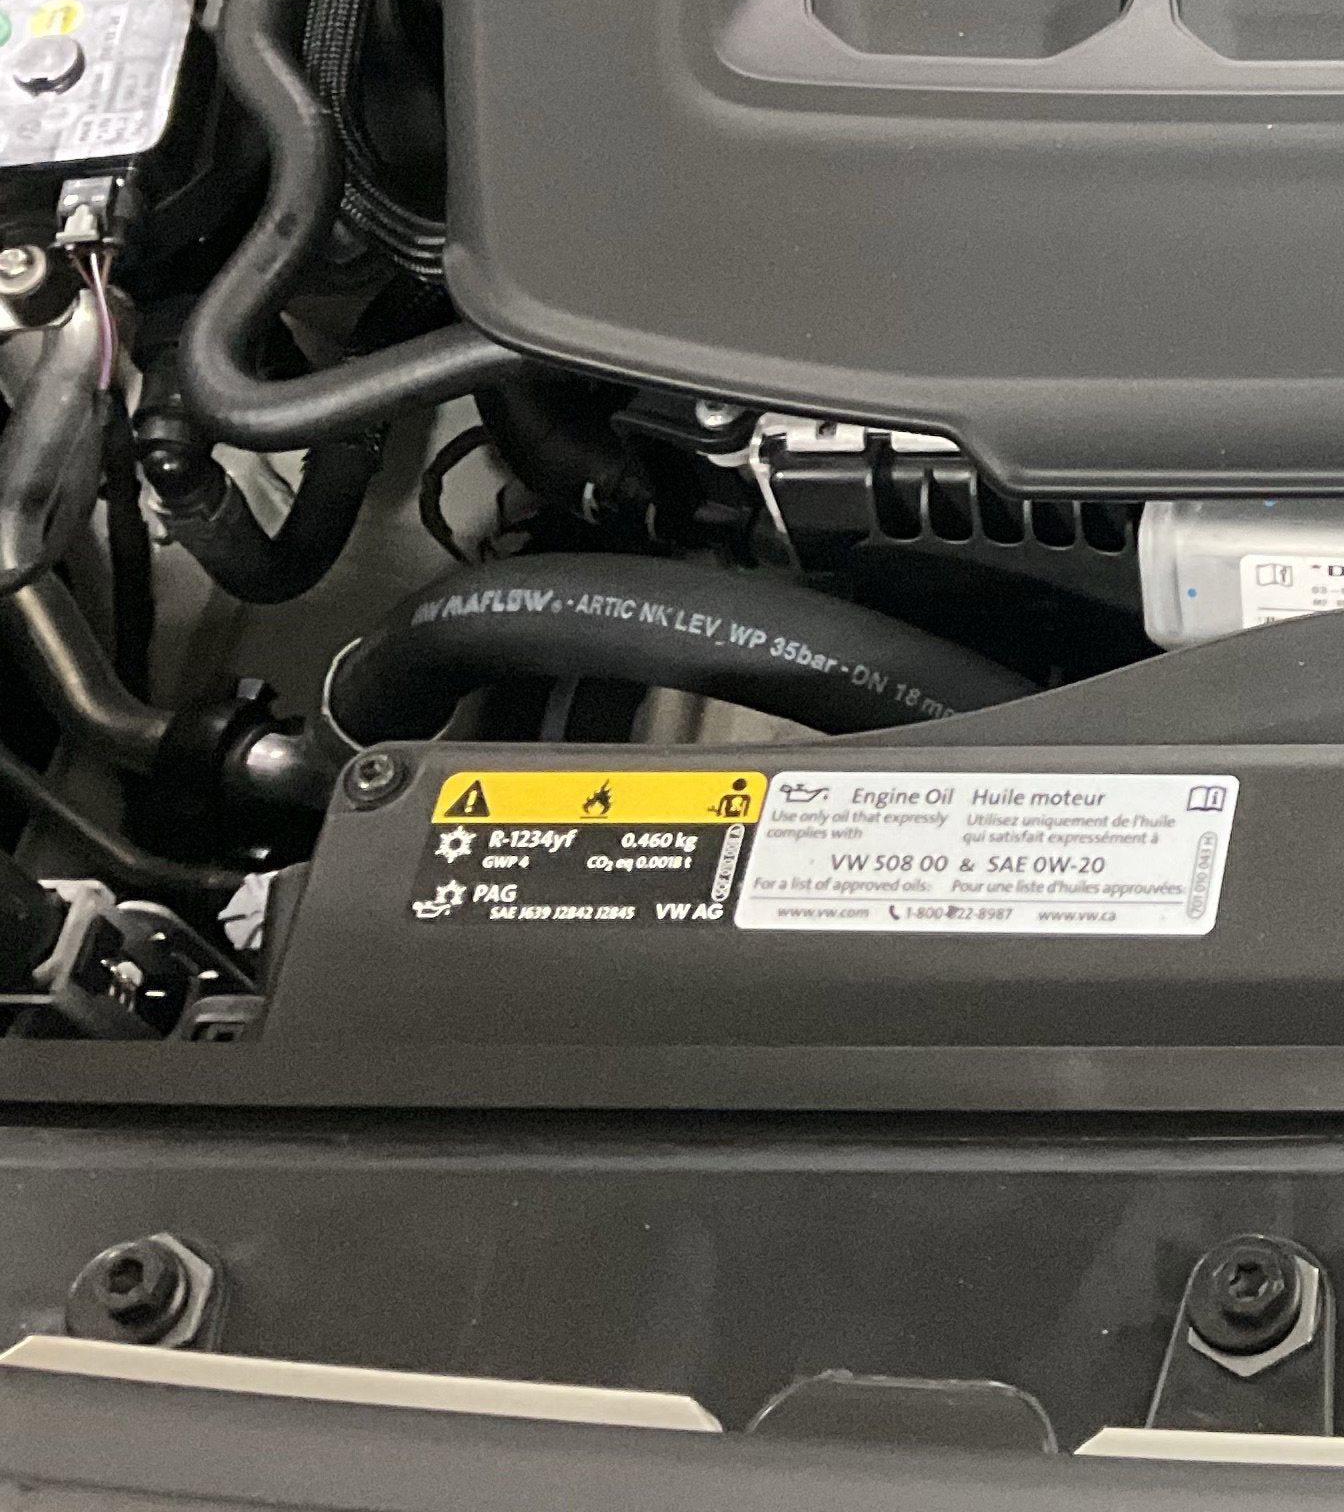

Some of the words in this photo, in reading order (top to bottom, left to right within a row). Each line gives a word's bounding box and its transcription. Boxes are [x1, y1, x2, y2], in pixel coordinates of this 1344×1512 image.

[575, 594, 636, 620] ARTIC
[770, 637, 838, 673] 35bar
[852, 664, 889, 694] DN
[894, 683, 921, 707] 18
[852, 788, 920, 809] Engine
[925, 788, 955, 805] Oil
[972, 789, 1025, 806] Huile
[1030, 792, 1106, 806] moteur
[772, 810, 797, 822] Use
[800, 810, 830, 825] only
[832, 811, 849, 823] oil
[852, 810, 880, 824] that
[884, 812, 949, 828] expressly
[967, 814, 1018, 827] Utilisez
[1022, 814, 1107, 831] uniquement
[1112, 814, 1130, 827] de
[1132, 814, 1176, 827] l'huile
[489, 829, 578, 853] R-1234yf
[621, 833, 672, 848] 0.460
[675, 831, 699, 852] kg
[767, 827, 827, 842] complies
[832, 827, 863, 838] with
[962, 832, 984, 846] qui
[989, 831, 1043, 844] satisfait
[1049, 831, 1147, 846] expressément
[1150, 832, 1160, 844] à
[482, 855, 516, 869] GWP
[517, 856, 530, 869] 4
[615, 858, 633, 872] eq
[831, 854, 870, 871] VW
[874, 855, 914, 872] 508
[919, 855, 949, 872] 00
[959, 858, 975, 872] &
[987, 856, 1028, 873] SAE
[1033, 856, 1106, 873] 0W-20
[472, 884, 518, 903] PAG
[754, 877, 777, 890] For
[778, 879, 788, 890] a
[791, 877, 812, 891] list
[815, 877, 832, 891] of
[833, 878, 899, 895] approved
[952, 880, 985, 893] Pour
[987, 882, 1013, 893] une
[1017, 880, 1044, 893] liste
[1047, 880, 1099, 894] d'huiles
[489, 905, 516, 920] SAE
[655, 903, 691, 920] VW
[693, 903, 724, 920] AG
[777, 906, 869, 918] www.vw.com
[1038, 909, 1117, 922] www.vw.ca
